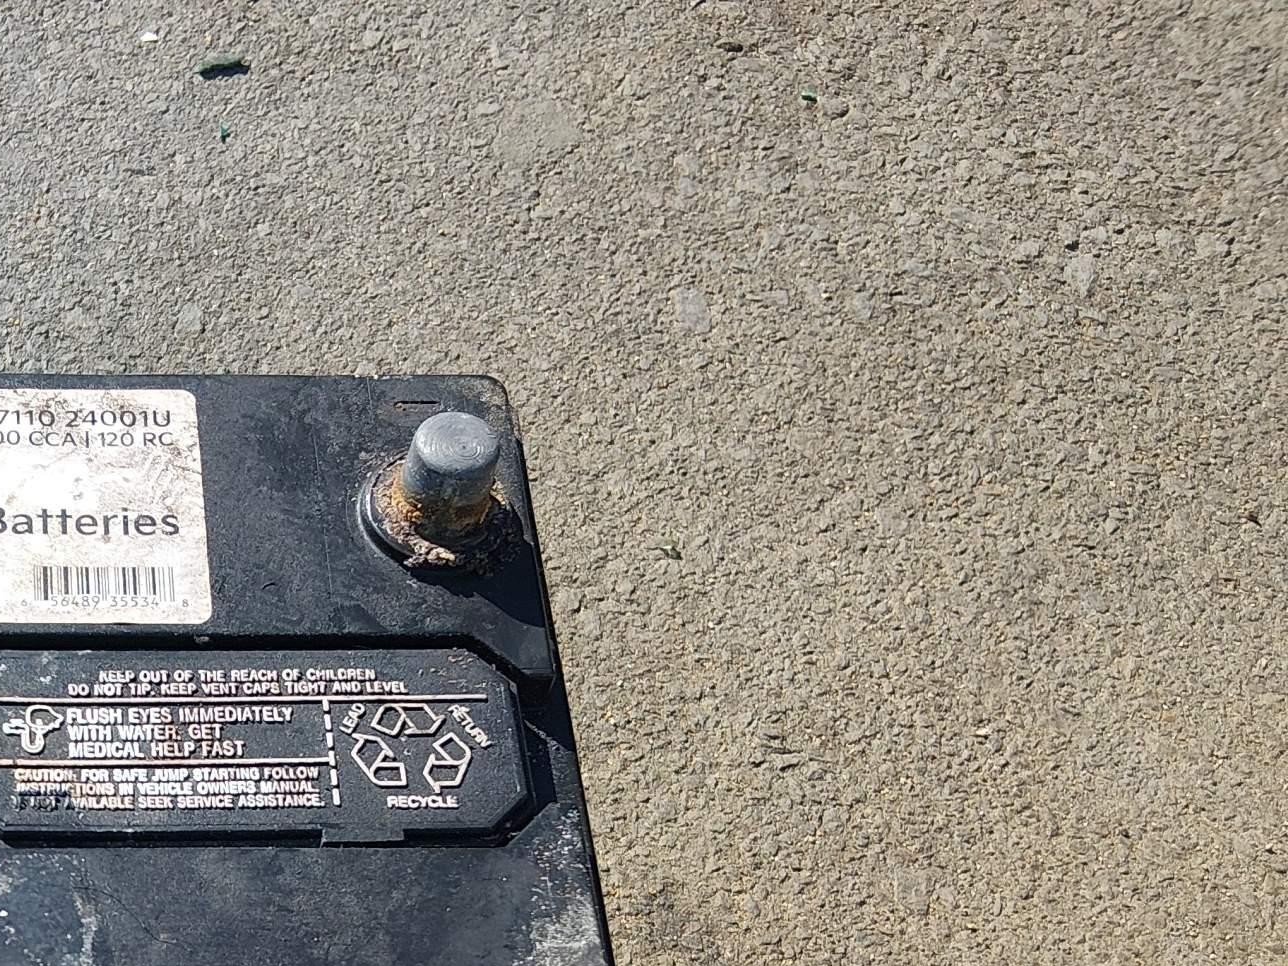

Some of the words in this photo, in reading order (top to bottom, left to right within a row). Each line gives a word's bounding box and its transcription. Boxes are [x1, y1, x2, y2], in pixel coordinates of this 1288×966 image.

[64, 409, 171, 428] 24001U
[28, 431, 78, 447] CCA
[97, 431, 135, 447] 120
[143, 432, 175, 447] RC
[50, 596, 101, 608] 56489
[109, 596, 160, 608] 35534
[181, 599, 190, 608] 8
[99, 670, 135, 683] KEEP
[139, 670, 168, 683] OUT
[173, 670, 194, 683] OF
[198, 670, 226, 682] THE
[230, 669, 278, 682] REACH
[282, 669, 302, 681] OF
[305, 668, 376, 681] CHILDREN
[67, 683, 89, 696] DO
[93, 683, 123, 696] NOT
[161, 683, 198, 696] KEEP
[202, 682, 239, 695] VENT
[245, 682, 280, 694] CAPS
[284, 681, 327, 694] TIGHT
[332, 681, 362, 694] AND
[365, 680, 409, 694] LEVEL
[66, 708, 122, 724] FLUSH
[127, 707, 172, 724] EYES
[178, 706, 294, 723] IMMEDIATELY
[339, 703, 367, 735] LEAD
[67, 724, 112, 741] WITH
[188, 723, 223, 740] GET
[447, 703, 493, 749] RETURN
[68, 741, 145, 758] MEDICAL
[150, 741, 196, 757] HELP
[202, 740, 245, 757] FAST
[80, 768, 110, 783] FOR
[112, 768, 148, 782] SAFE
[151, 768, 189, 782] JUMP
[192, 767, 260, 781] STARTING
[263, 766, 320, 780] FOLLOW
[118, 782, 135, 796] IN
[137, 782, 193, 796] VEHICLE
[196, 781, 257, 795] OWNERS
[138, 795, 174, 809] SEEK
[177, 795, 234, 808] SERVICE
[386, 794, 460, 809] RECYCLE
